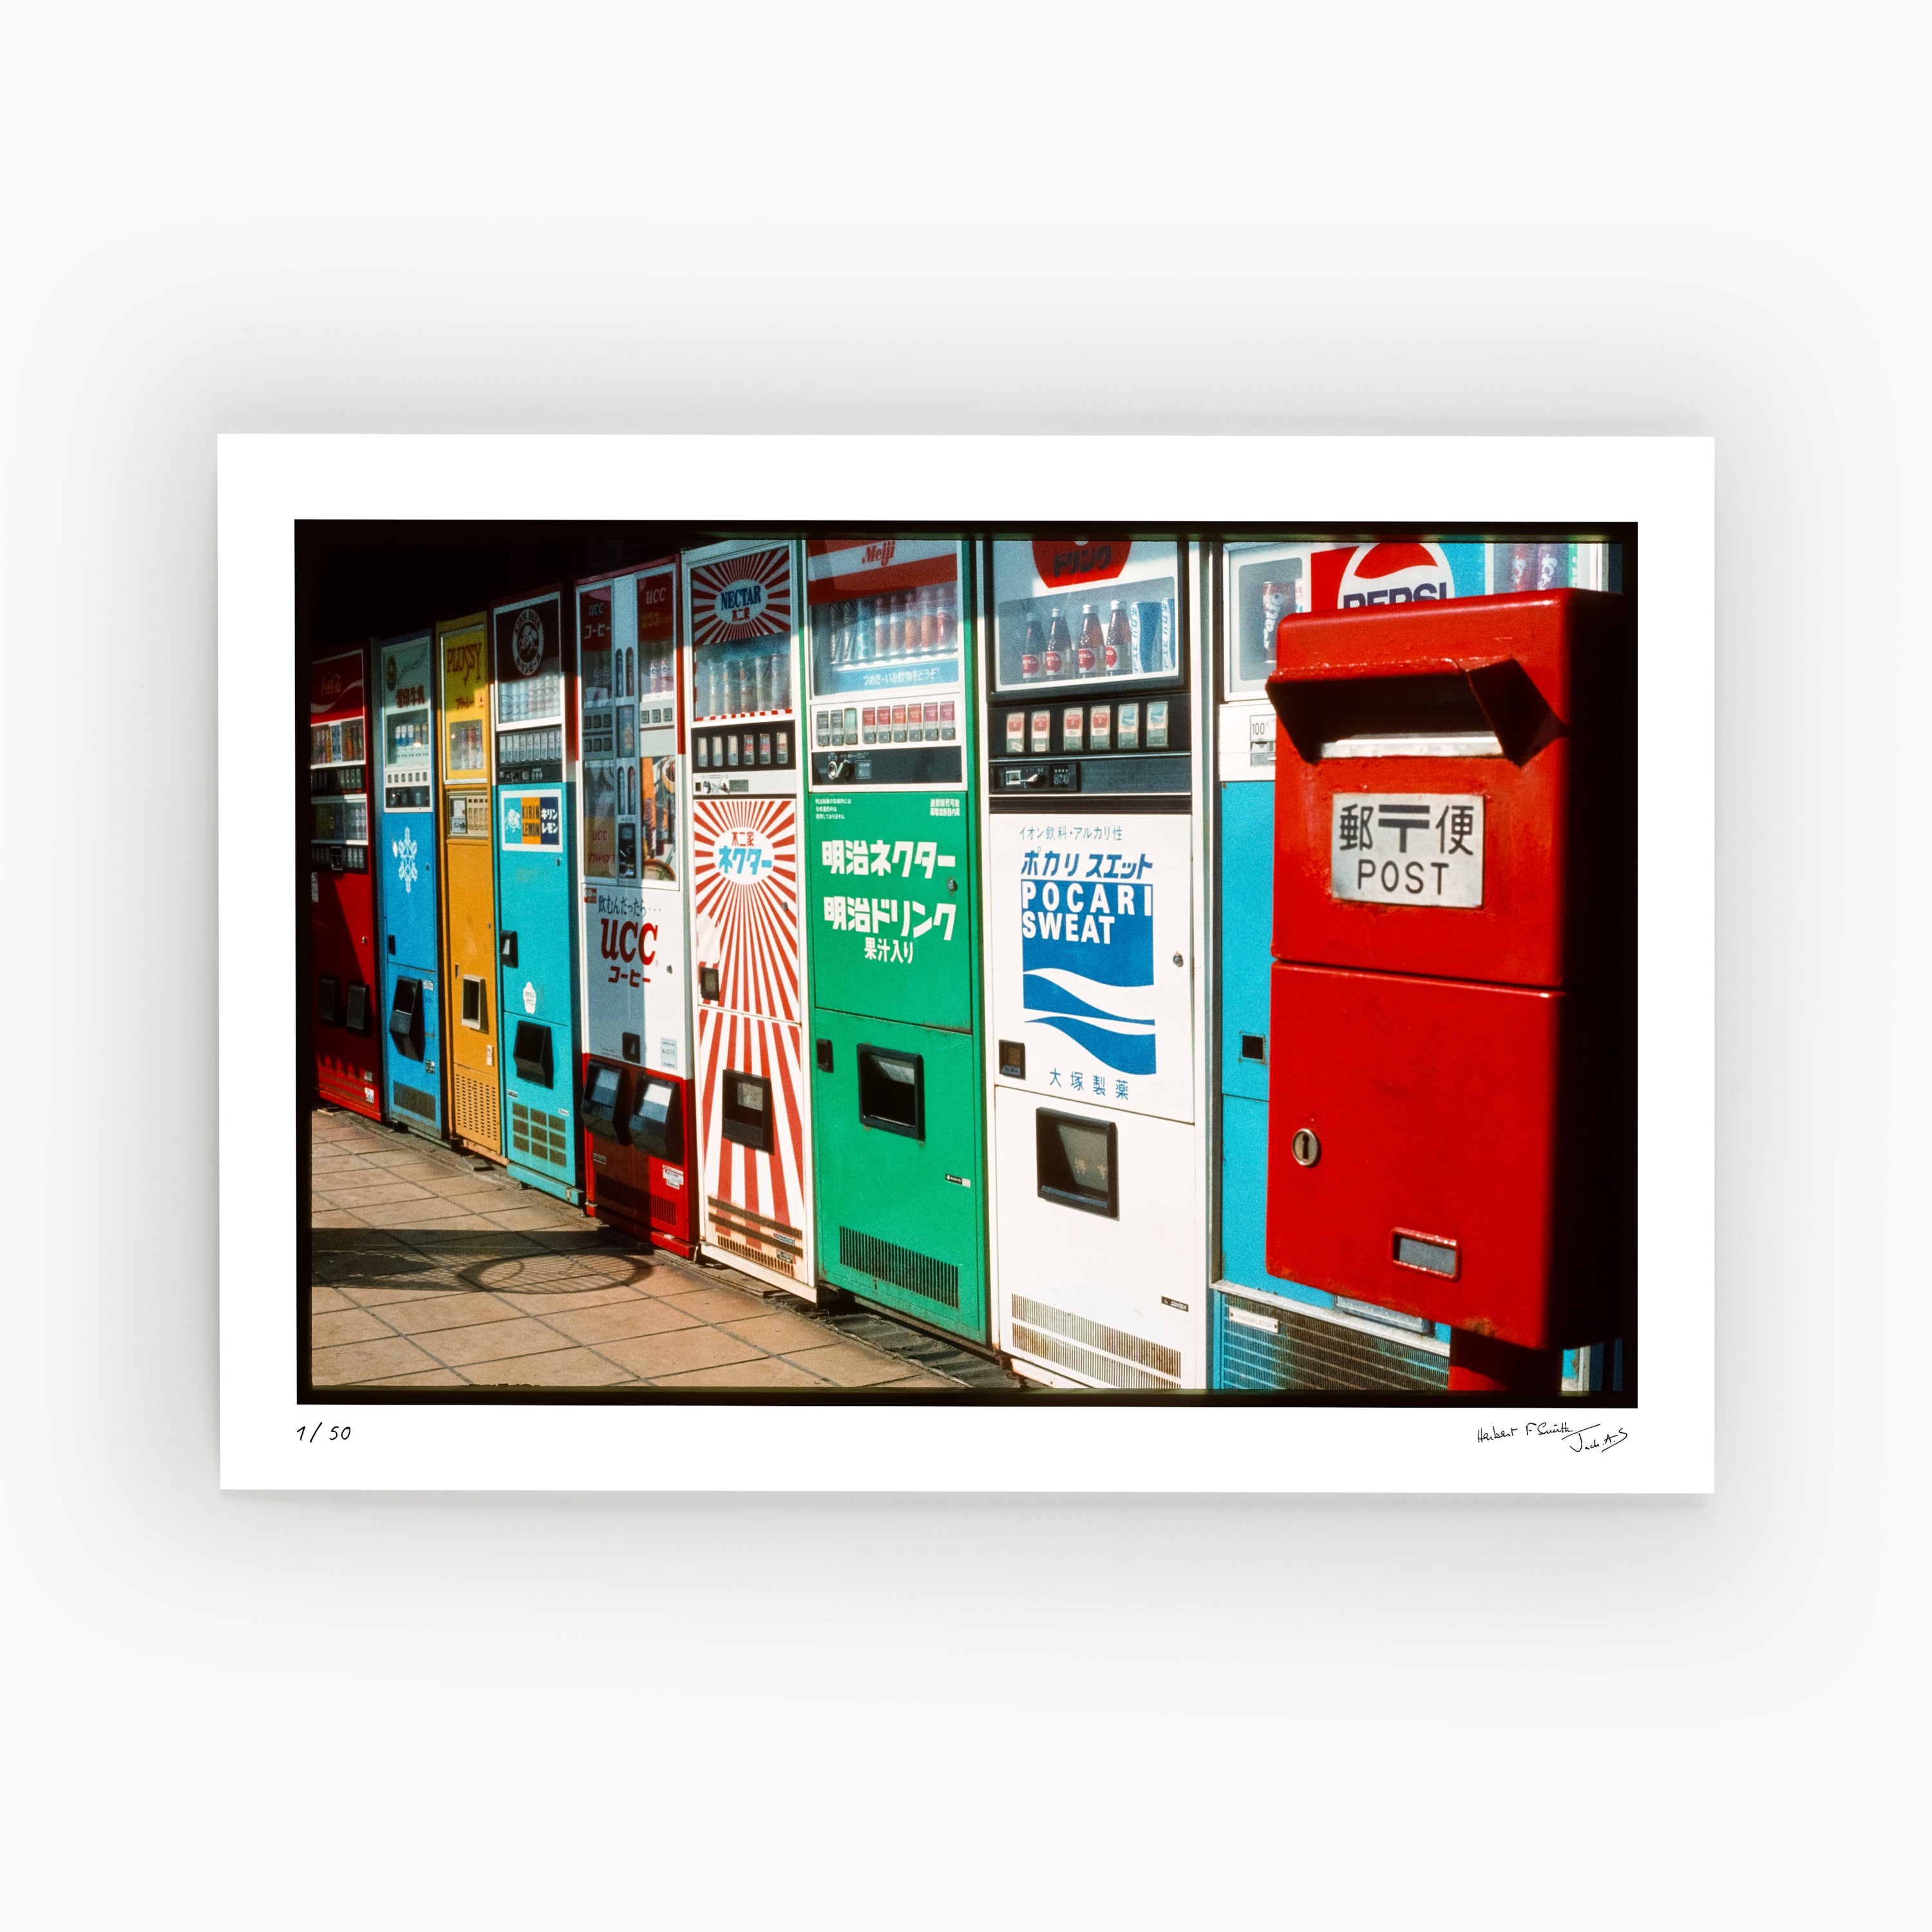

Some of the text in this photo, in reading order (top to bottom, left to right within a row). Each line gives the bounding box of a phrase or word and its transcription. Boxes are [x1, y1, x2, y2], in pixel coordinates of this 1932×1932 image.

[862, 540, 895, 566] Meiji
[1054, 545, 1112, 577] ドリンク
[721, 585, 761, 610] NECTAR
[522, 806, 540, 820] KIRIN
[541, 808, 558, 820] キリン
[542, 822, 558, 834] レモン
[732, 831, 755, 847] 不二家
[719, 845, 772, 875] ネクター
[822, 839, 956, 878] 明治ネクター
[1358, 859, 1449, 895] POST
[1022, 882, 1152, 916] POCARI
[824, 896, 956, 941] 明治ドリンク
[1022, 911, 1115, 944] SWEAT
[864, 937, 914, 964] 果汁入り
[608, 965, 651, 988] コーヒー
[1050, 1068, 1129, 1100] 大塚製薬
